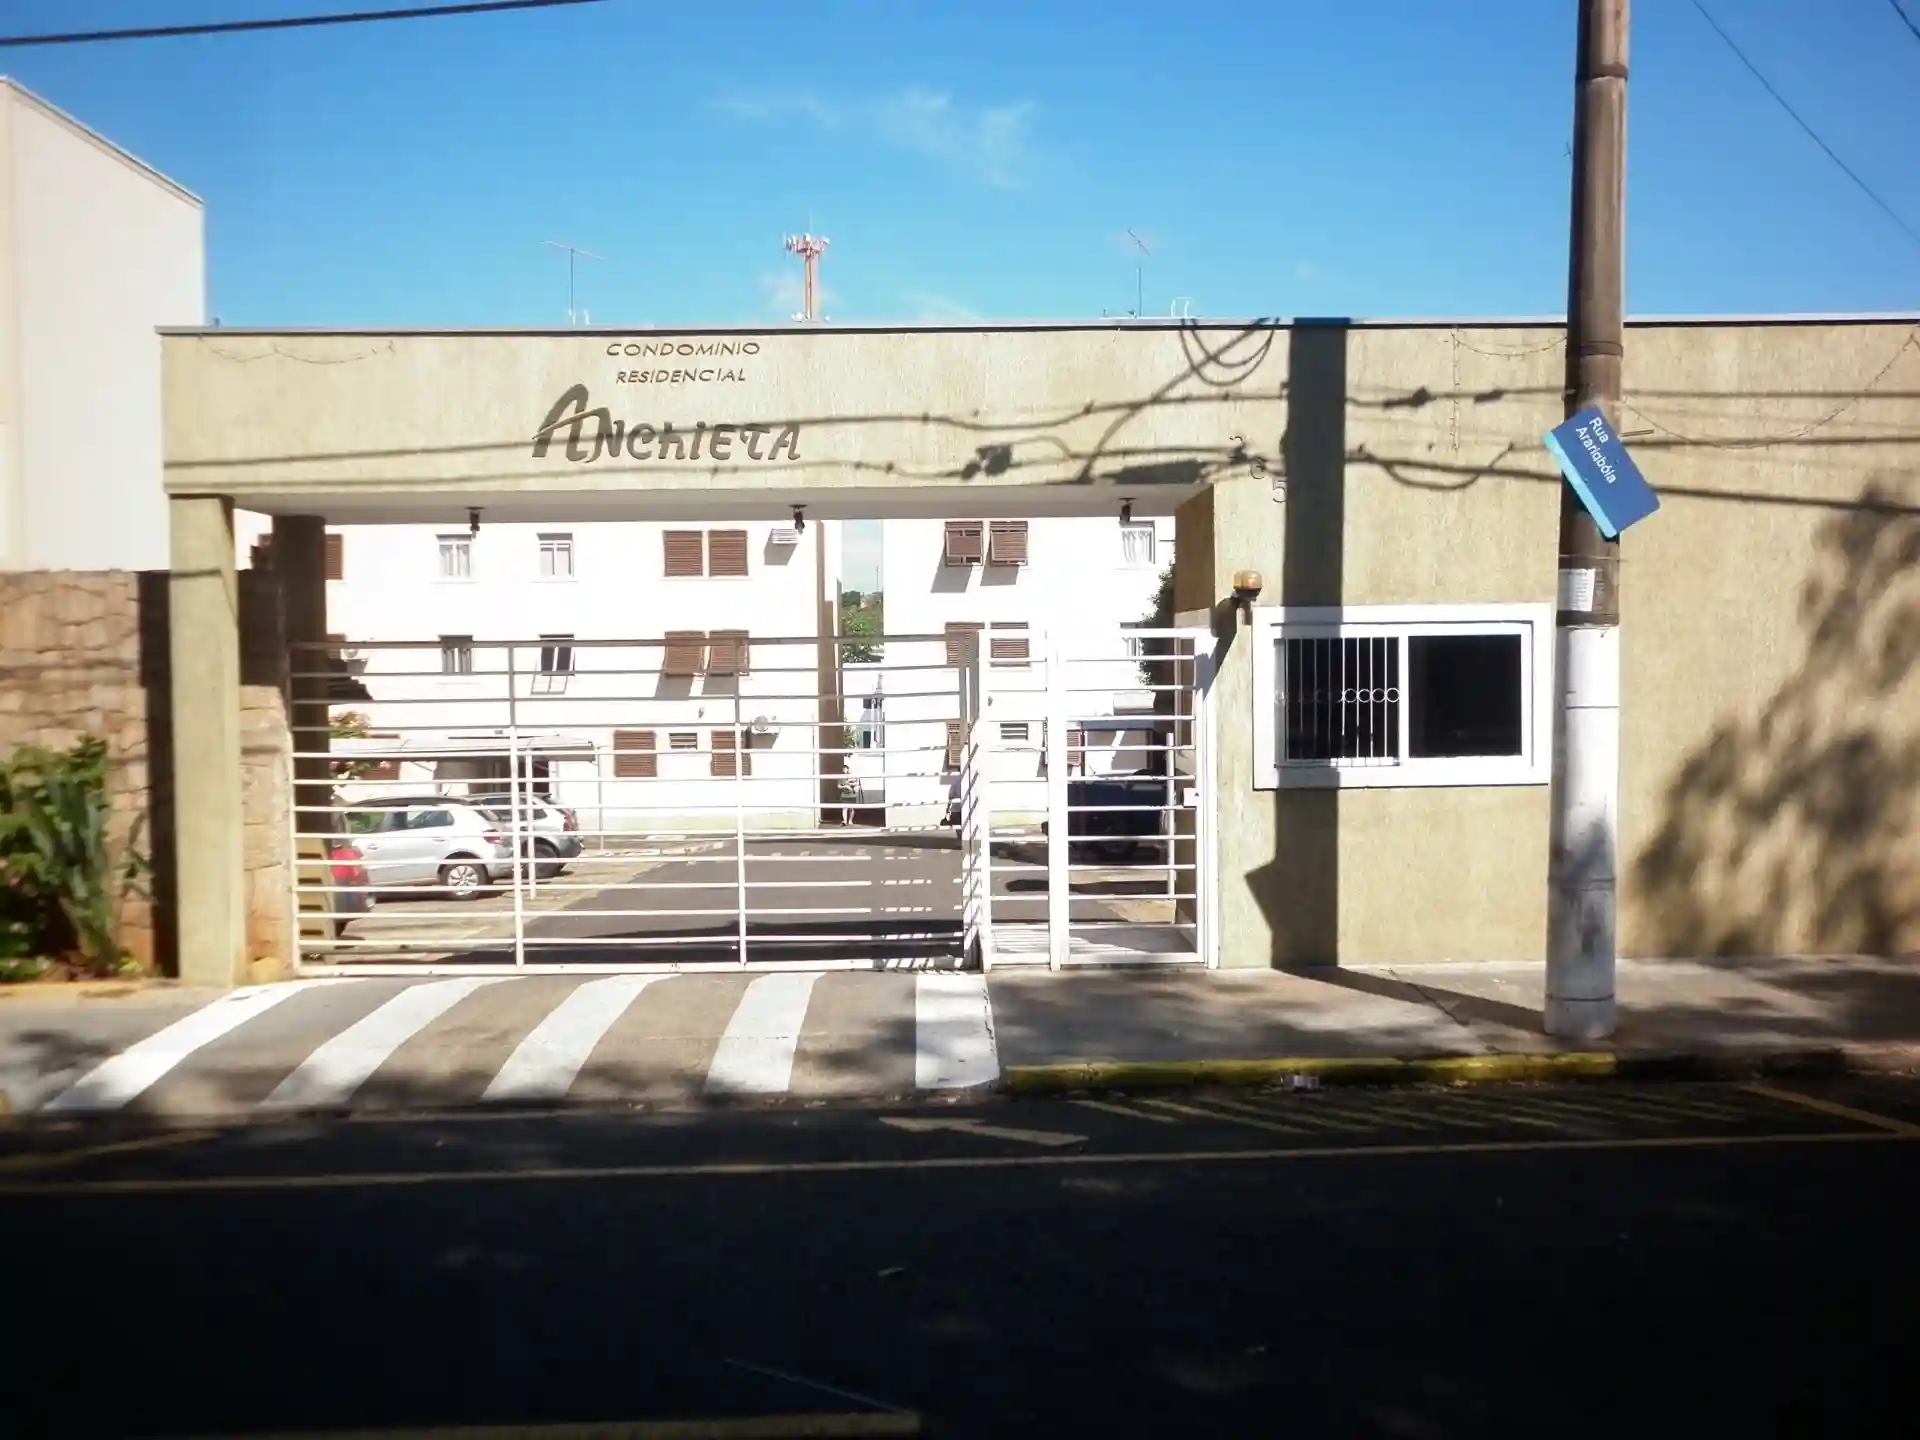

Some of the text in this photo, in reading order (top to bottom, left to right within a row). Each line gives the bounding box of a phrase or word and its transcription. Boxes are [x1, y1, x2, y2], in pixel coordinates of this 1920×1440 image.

[606, 341, 760, 357] CONDOMINIO
[616, 368, 746, 383] RESIDENCIAL
[1588, 416, 1609, 443] Rua
